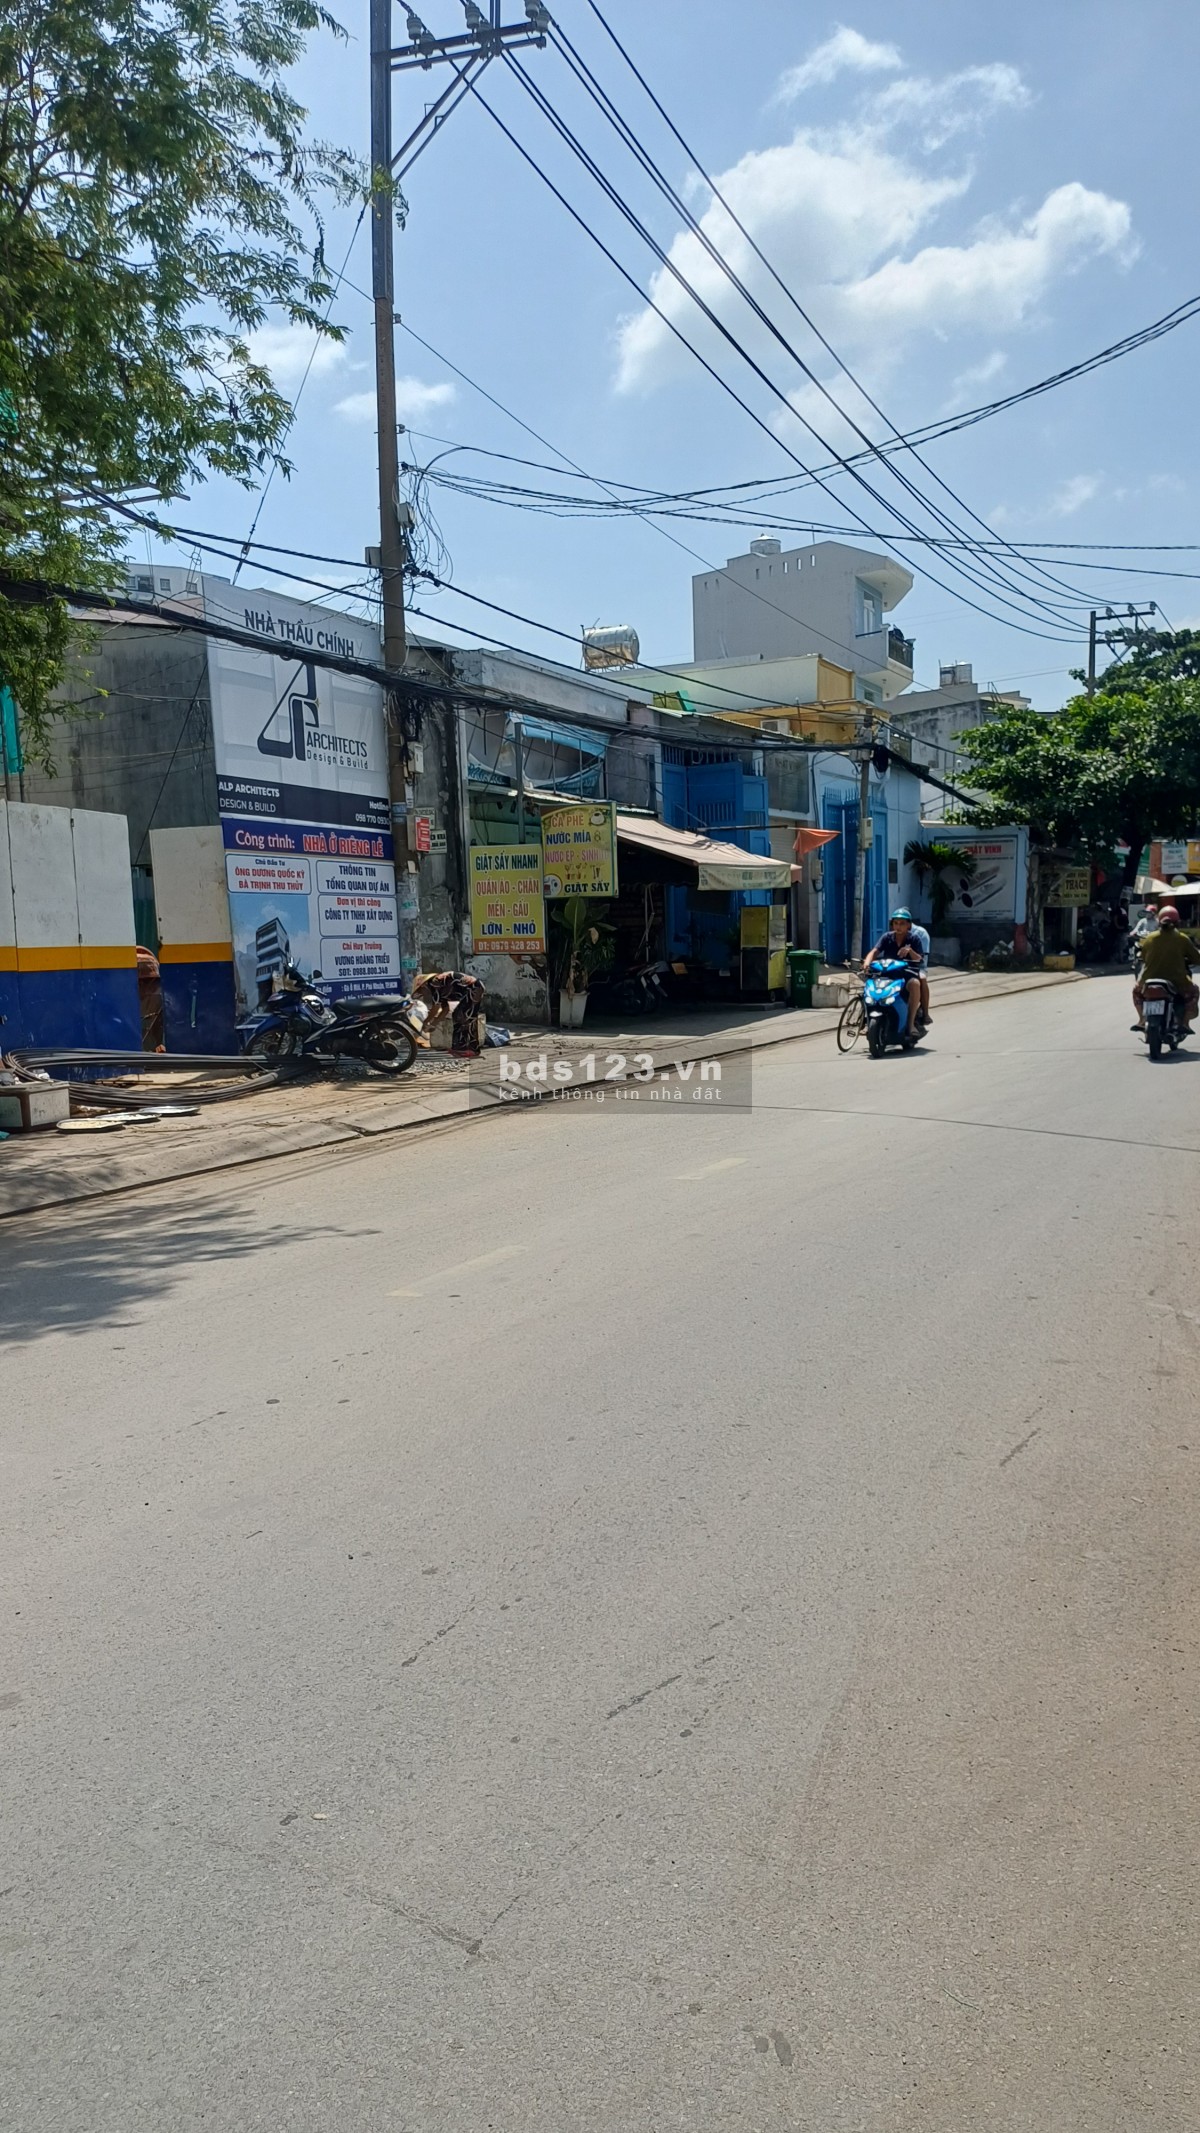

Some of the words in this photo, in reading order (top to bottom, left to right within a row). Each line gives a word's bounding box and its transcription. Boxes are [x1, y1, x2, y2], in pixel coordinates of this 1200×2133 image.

[244, 608, 276, 635] NHÀ
[278, 619, 313, 646] THẦU
[316, 631, 354, 657] CHÍNH
[306, 731, 368, 758] ARCHITECTS
[307, 750, 337, 765] Design
[339, 755, 345, 765] &
[346, 755, 369, 769] Build
[219, 781, 233, 792] ALP
[235, 782, 280, 797] ARCHITECTS
[219, 798, 247, 810] DESIGN
[248, 801, 253, 810] &
[255, 801, 276, 813] BUILD
[551, 813, 564, 828] CÀ
[566, 811, 585, 827] PHÊ
[235, 830, 265, 849] Công
[267, 833, 295, 849] trình:
[303, 832, 327, 853] NHÀ
[329, 831, 337, 853] Ở
[339, 836, 370, 856] RIÊNG
[372, 836, 384, 858] LẺ
[546, 830, 571, 845] NƯỚC
[573, 829, 592, 843] MÍA
[494, 850, 510, 870] SẤY
[511, 854, 539, 870] NHANH
[234, 866, 251, 876] ÔNG
[252, 868, 276, 877] DƯƠNG
[277, 867, 295, 879] QUỐC
[338, 864, 363, 876] THÔNG
[364, 867, 376, 877] TIN
[238, 878, 249, 889] BÀ
[250, 880, 271, 891] TRỊNH
[272, 881, 285, 890] THU
[325, 876, 346, 890] TỔNG
[347, 880, 367, 891] QUAN
[368, 881, 379, 894] DỰ
[379, 880, 390, 892] ÁN
[499, 878, 510, 895] ÁO
[591, 880, 610, 892] SẤY
[325, 907, 342, 920] CÔNG
[342, 910, 350, 920] TY
[350, 910, 366, 920] TNHH
[366, 908, 377, 920] XÂY
[378, 911, 393, 923] DỰNG
[513, 898, 529, 917] GẤU
[355, 924, 367, 934] ALP
[481, 921, 503, 935] LỚN
[513, 919, 536, 935] NHỎ
[526, 941, 540, 950] 253
[334, 955, 355, 966] VƯƠNG
[355, 953, 374, 965] HOÀNG
